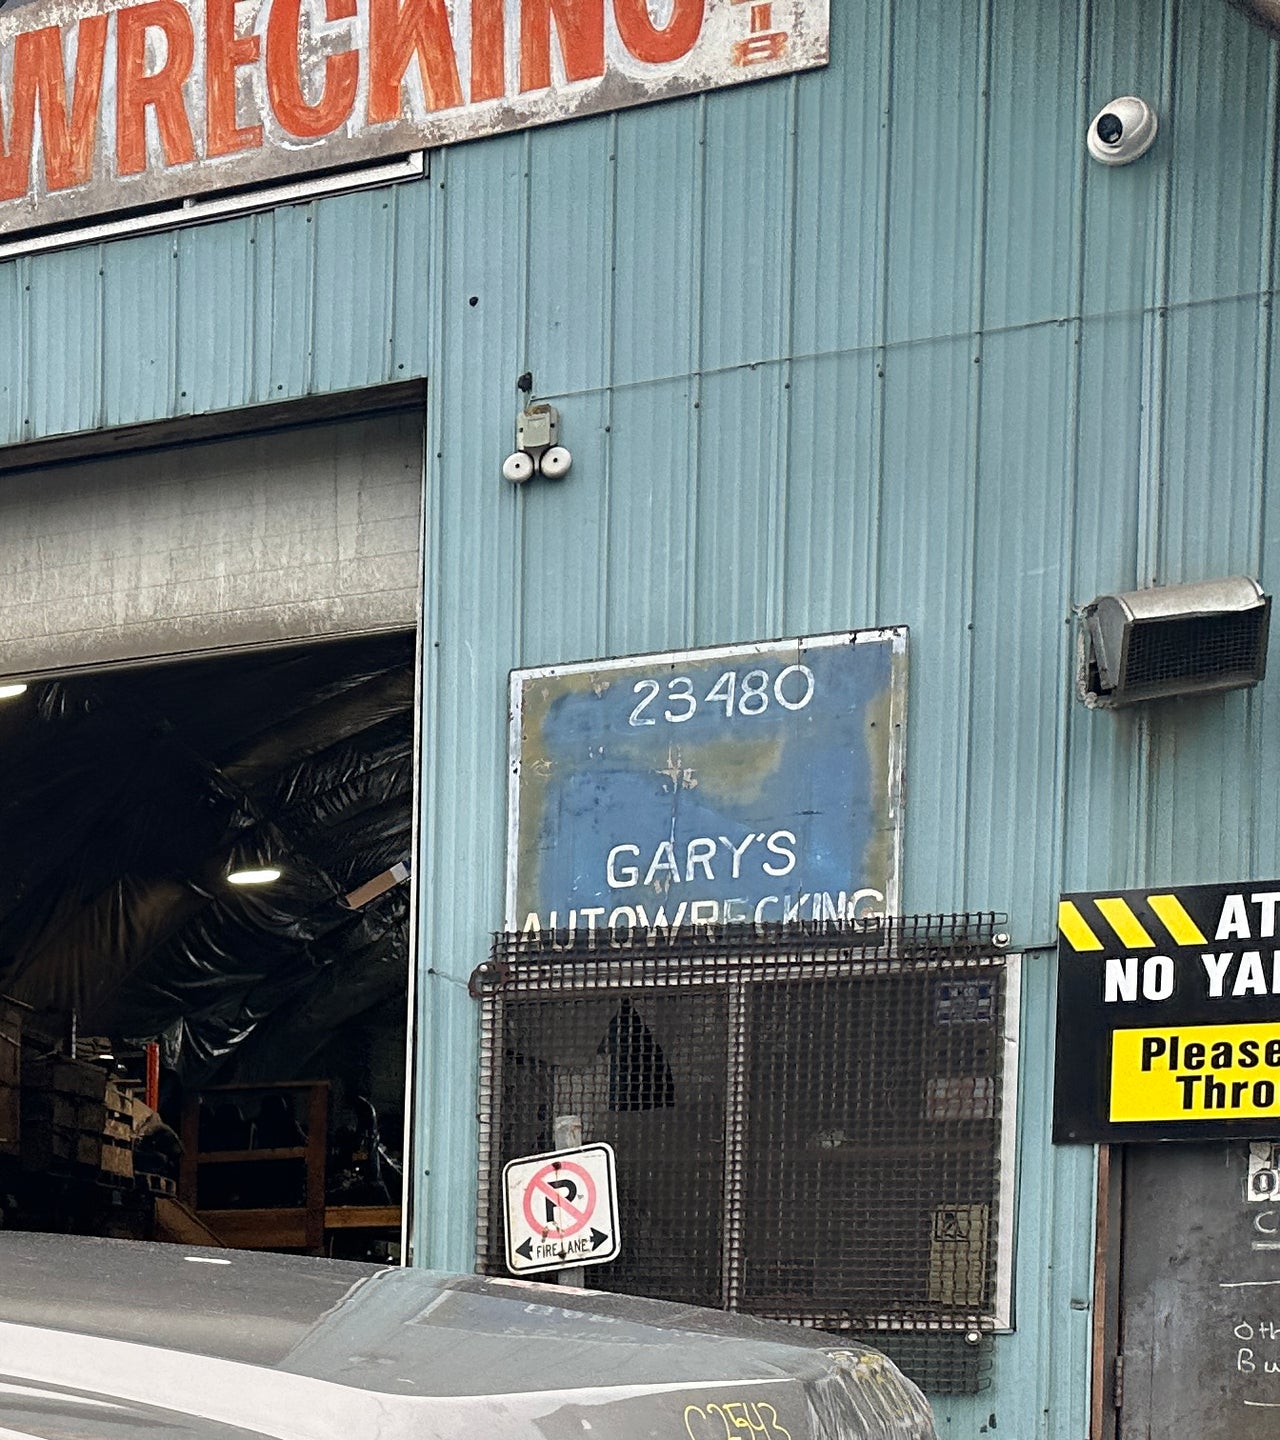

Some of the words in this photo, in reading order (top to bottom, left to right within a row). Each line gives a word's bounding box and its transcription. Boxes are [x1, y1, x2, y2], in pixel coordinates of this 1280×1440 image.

[629, 665, 815, 726] 23480
[607, 831, 797, 888] GARY'S
[1105, 955, 1174, 1002] NO
[1141, 1036, 1280, 1072] Please
[1175, 1074, 1274, 1110] Thro
[536, 1242, 558, 1260] FIRE
